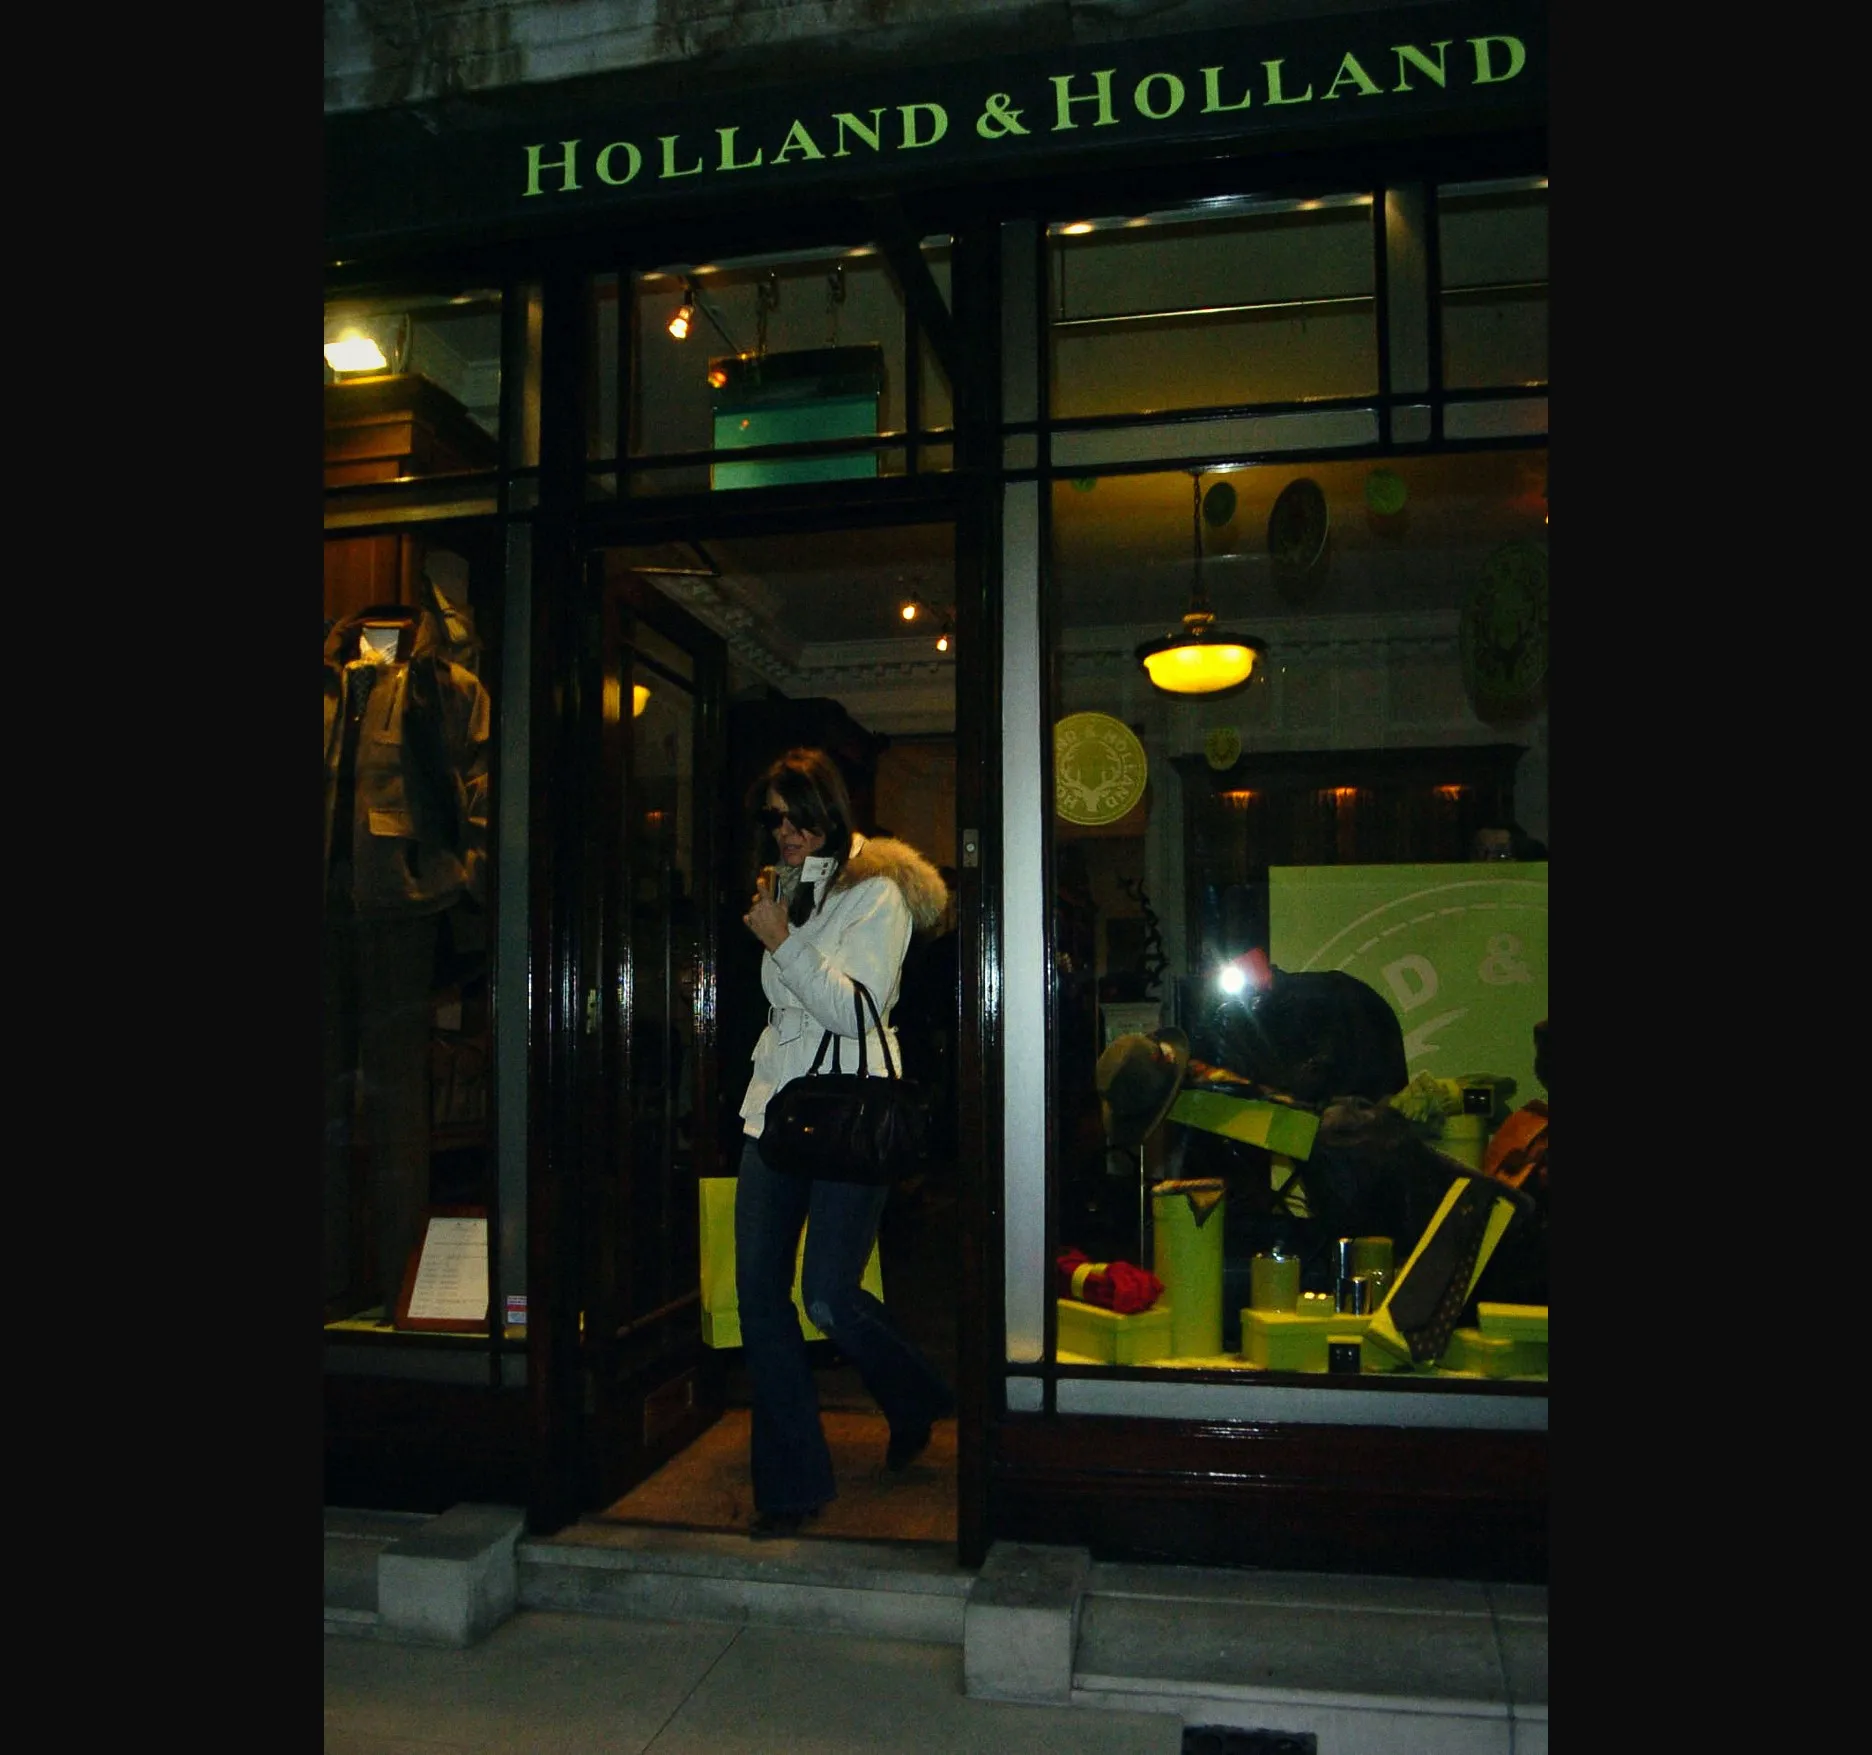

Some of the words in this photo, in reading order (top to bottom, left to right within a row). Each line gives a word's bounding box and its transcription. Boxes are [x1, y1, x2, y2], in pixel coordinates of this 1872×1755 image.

[521, 103, 949, 197] HOLLAND
[975, 92, 1032, 139] &
[1049, 35, 1528, 132] HOLLAND
[1478, 932, 1532, 986] &
